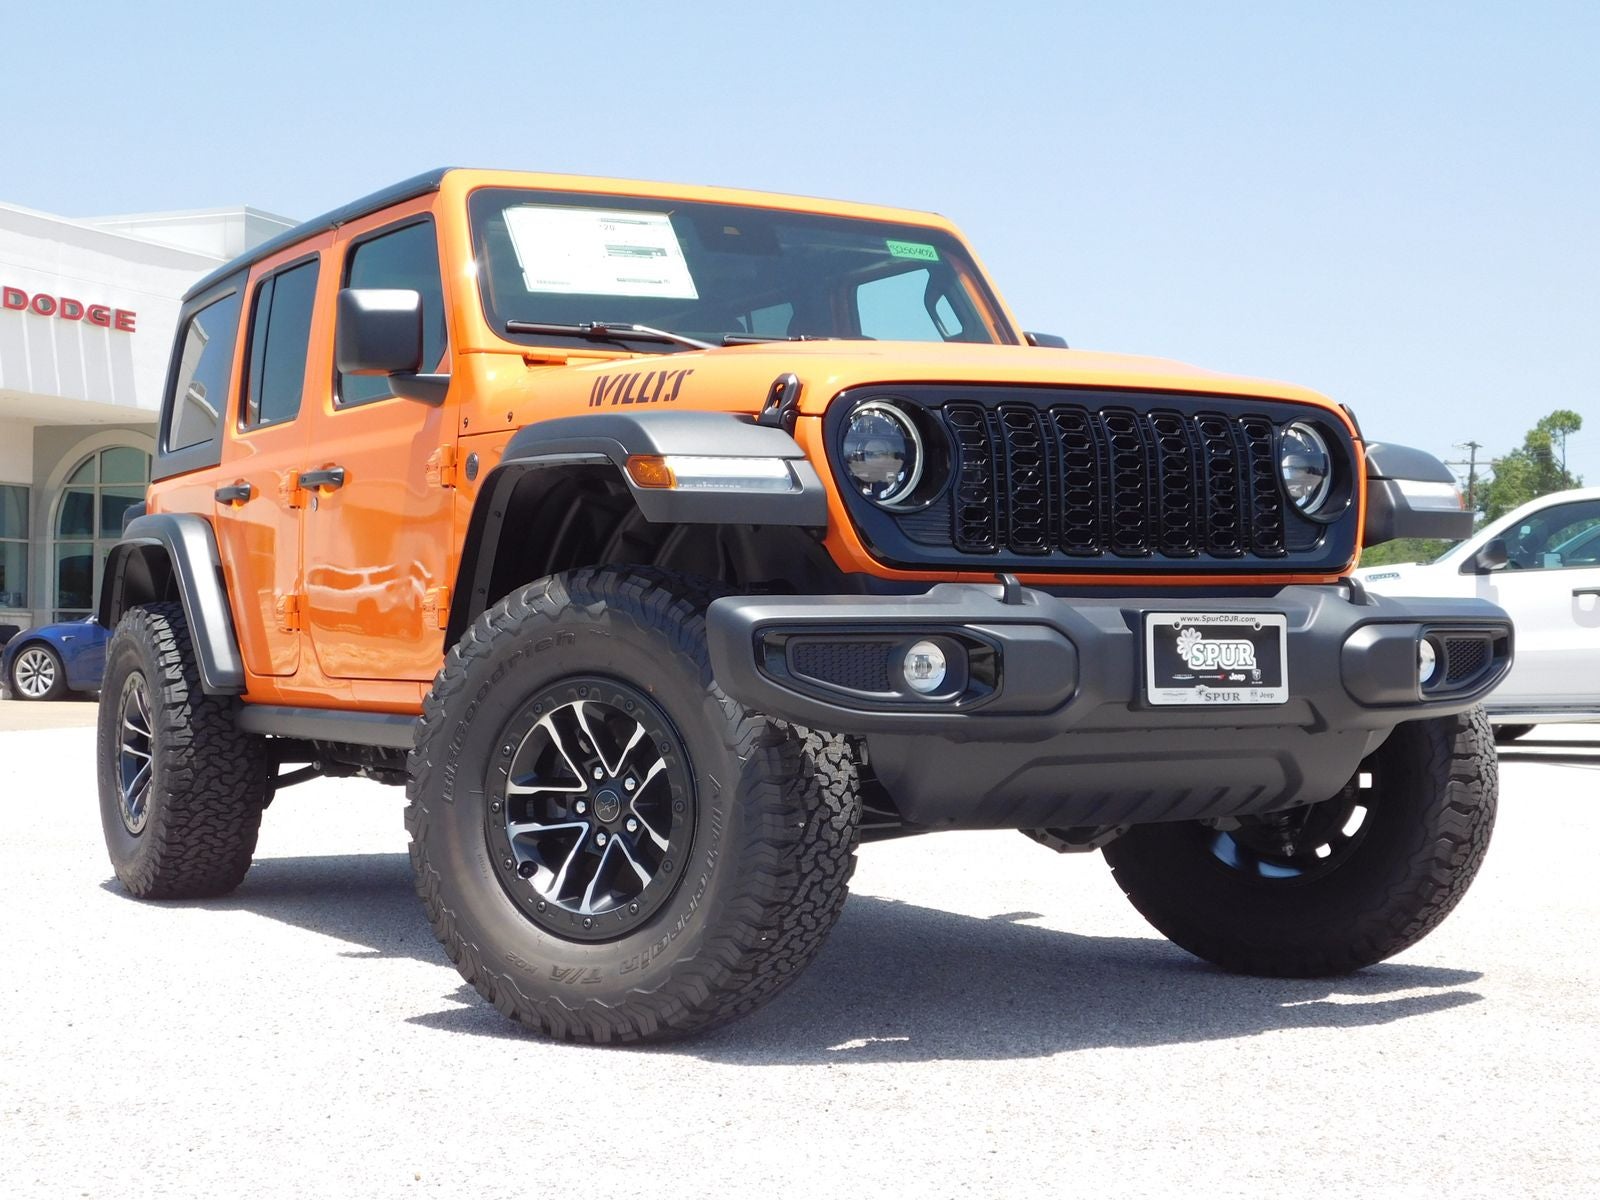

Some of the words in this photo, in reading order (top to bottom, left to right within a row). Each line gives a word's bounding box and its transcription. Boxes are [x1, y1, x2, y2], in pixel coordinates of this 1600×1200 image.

[2, 285, 137, 333] DODGE
[589, 369, 695, 407] WILLYS
[1180, 615, 1256, 623] www.SpurCDJR.com
[1190, 642, 1254, 667] SPUR
[1229, 673, 1246, 682] Jeep
[1205, 692, 1240, 702] SPUR
[1260, 691, 1275, 699] Jeep
